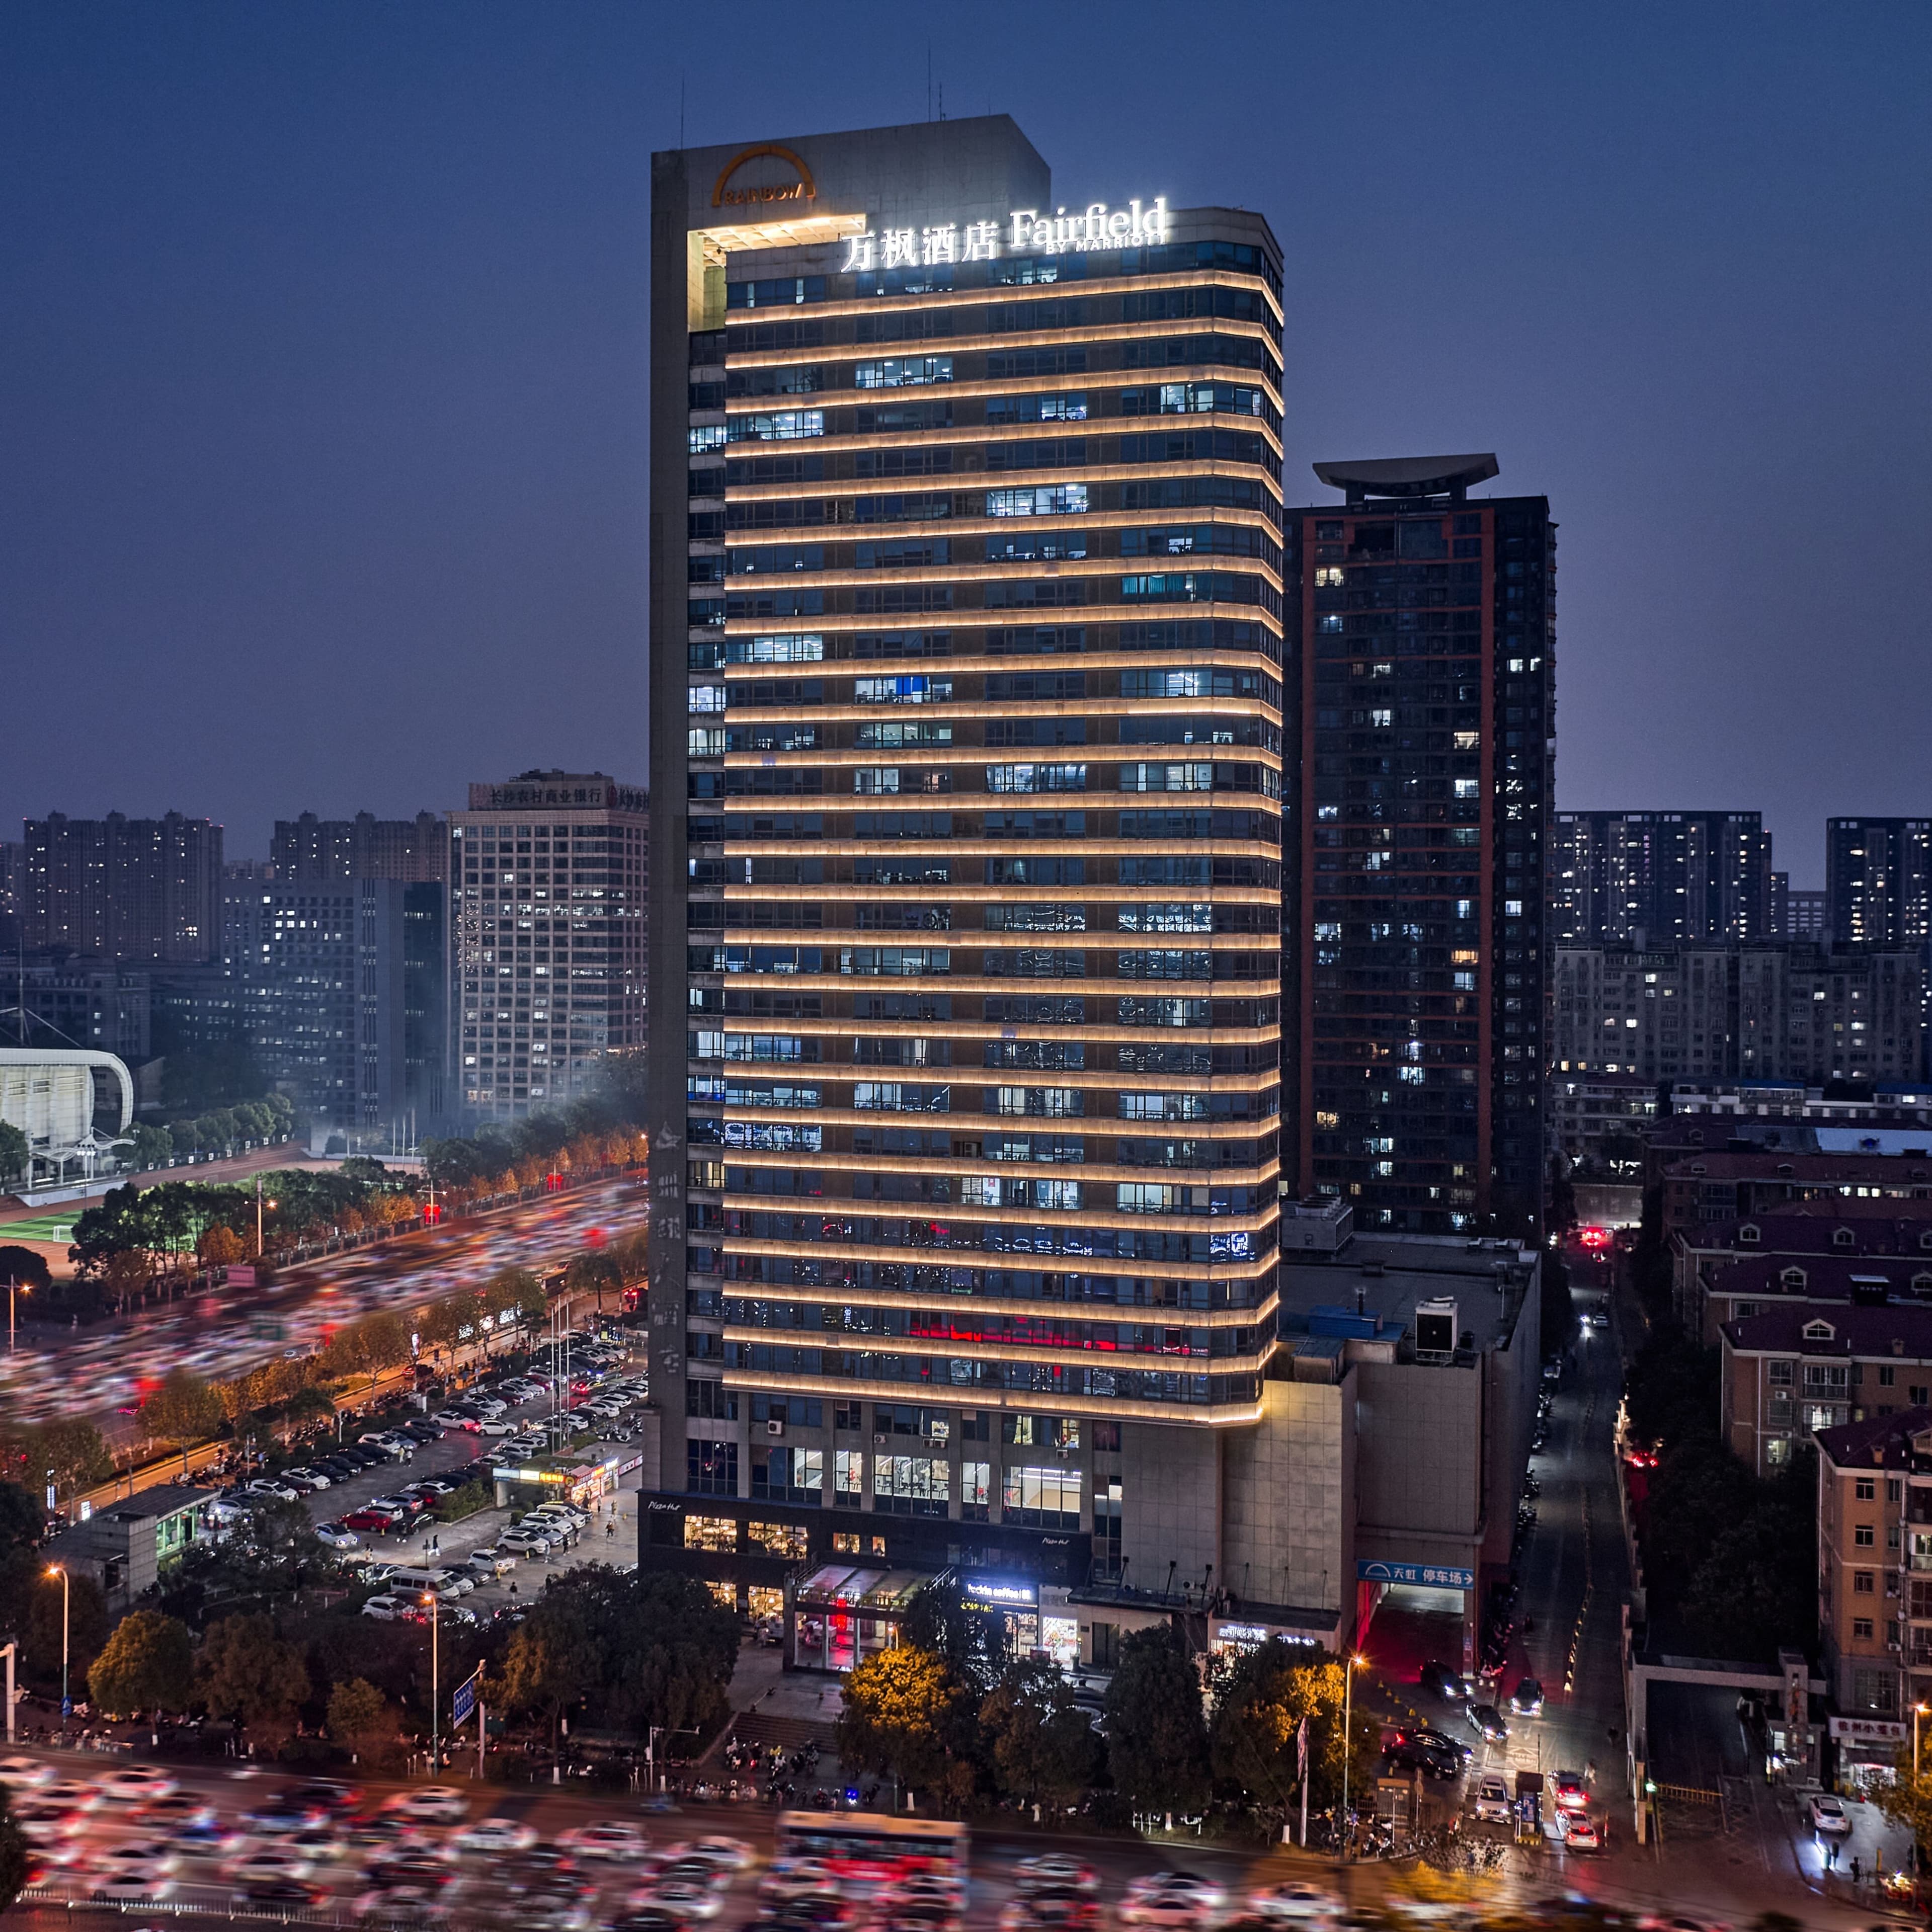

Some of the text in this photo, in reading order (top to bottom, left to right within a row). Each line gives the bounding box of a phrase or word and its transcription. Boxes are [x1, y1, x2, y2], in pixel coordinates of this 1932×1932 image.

[725, 184, 802, 204] RAINBOW
[1009, 198, 1167, 249] Fairfield
[841, 222, 998, 273] 万枫酒店
[1045, 233, 1167, 255] BY MARRIOTT
[648, 1501, 681, 1511] Pizza Hut
[1394, 1568, 1462, 1584] 天虹 停车场
